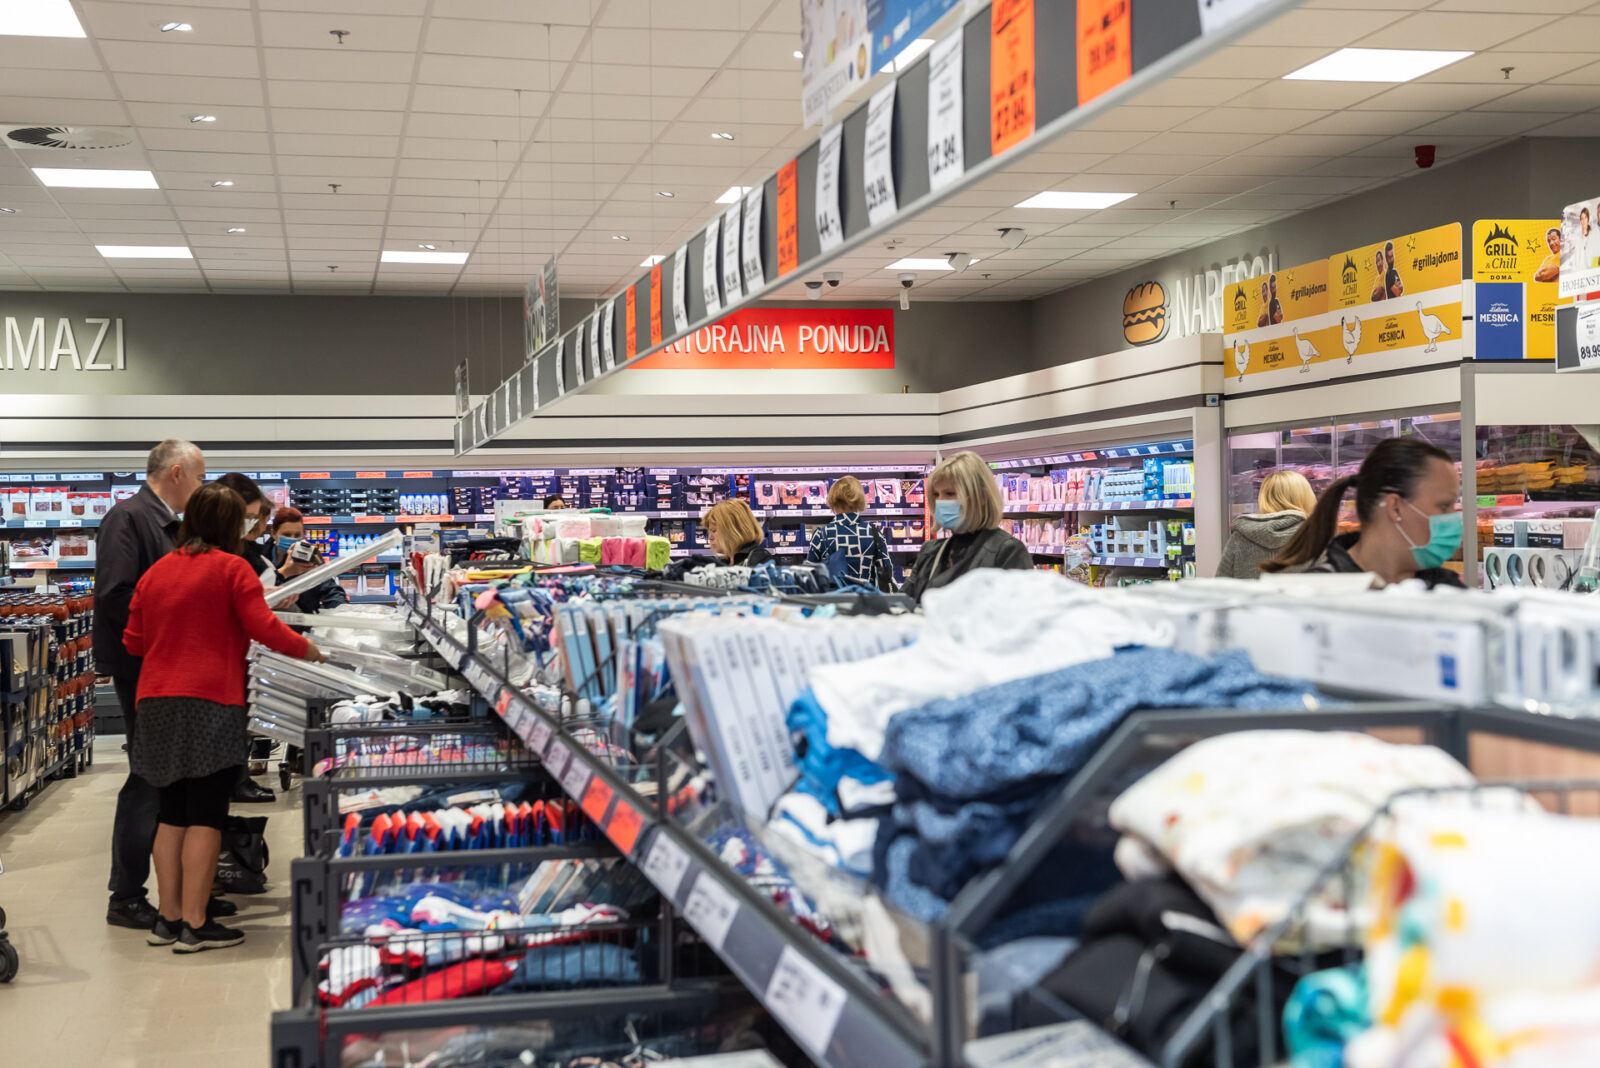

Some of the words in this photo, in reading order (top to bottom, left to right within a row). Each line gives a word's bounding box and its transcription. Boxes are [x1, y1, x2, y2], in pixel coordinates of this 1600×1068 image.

[1485, 243, 1517, 256] GRILL
[1412, 251, 1459, 271] #grillajdoma
[1491, 258, 1518, 269] Chill
[1343, 271, 1357, 284] GRILL
[1291, 284, 1327, 301] #grillajdoma
[1479, 313, 1519, 322] MESNICA
[799, 325, 890, 353] PONUDA
[1378, 329, 1406, 343] MESNICA
